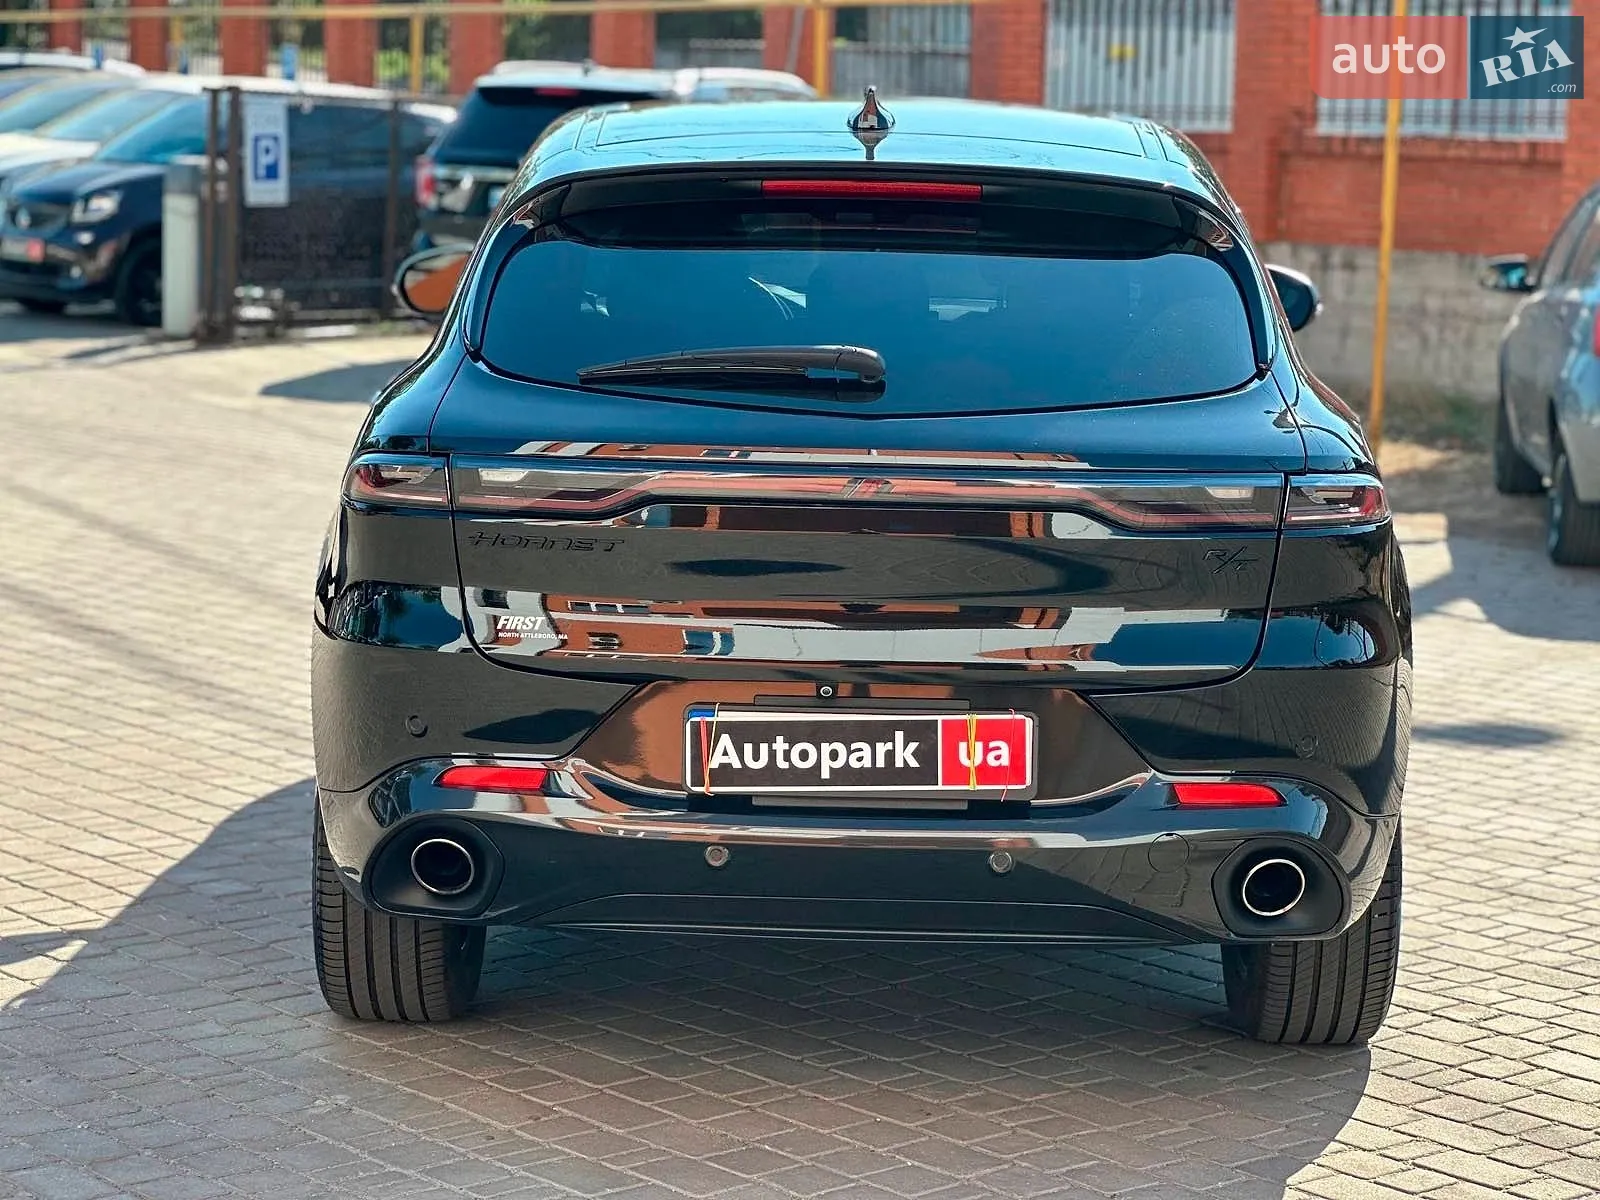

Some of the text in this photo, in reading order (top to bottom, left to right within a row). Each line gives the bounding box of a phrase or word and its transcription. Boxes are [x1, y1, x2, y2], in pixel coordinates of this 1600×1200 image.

[257, 139, 277, 178] P
[468, 531, 625, 552] HORNET
[1202, 545, 1259, 574] R/T
[496, 615, 546, 630] FIRST
[709, 730, 1010, 779] Autopark ua
